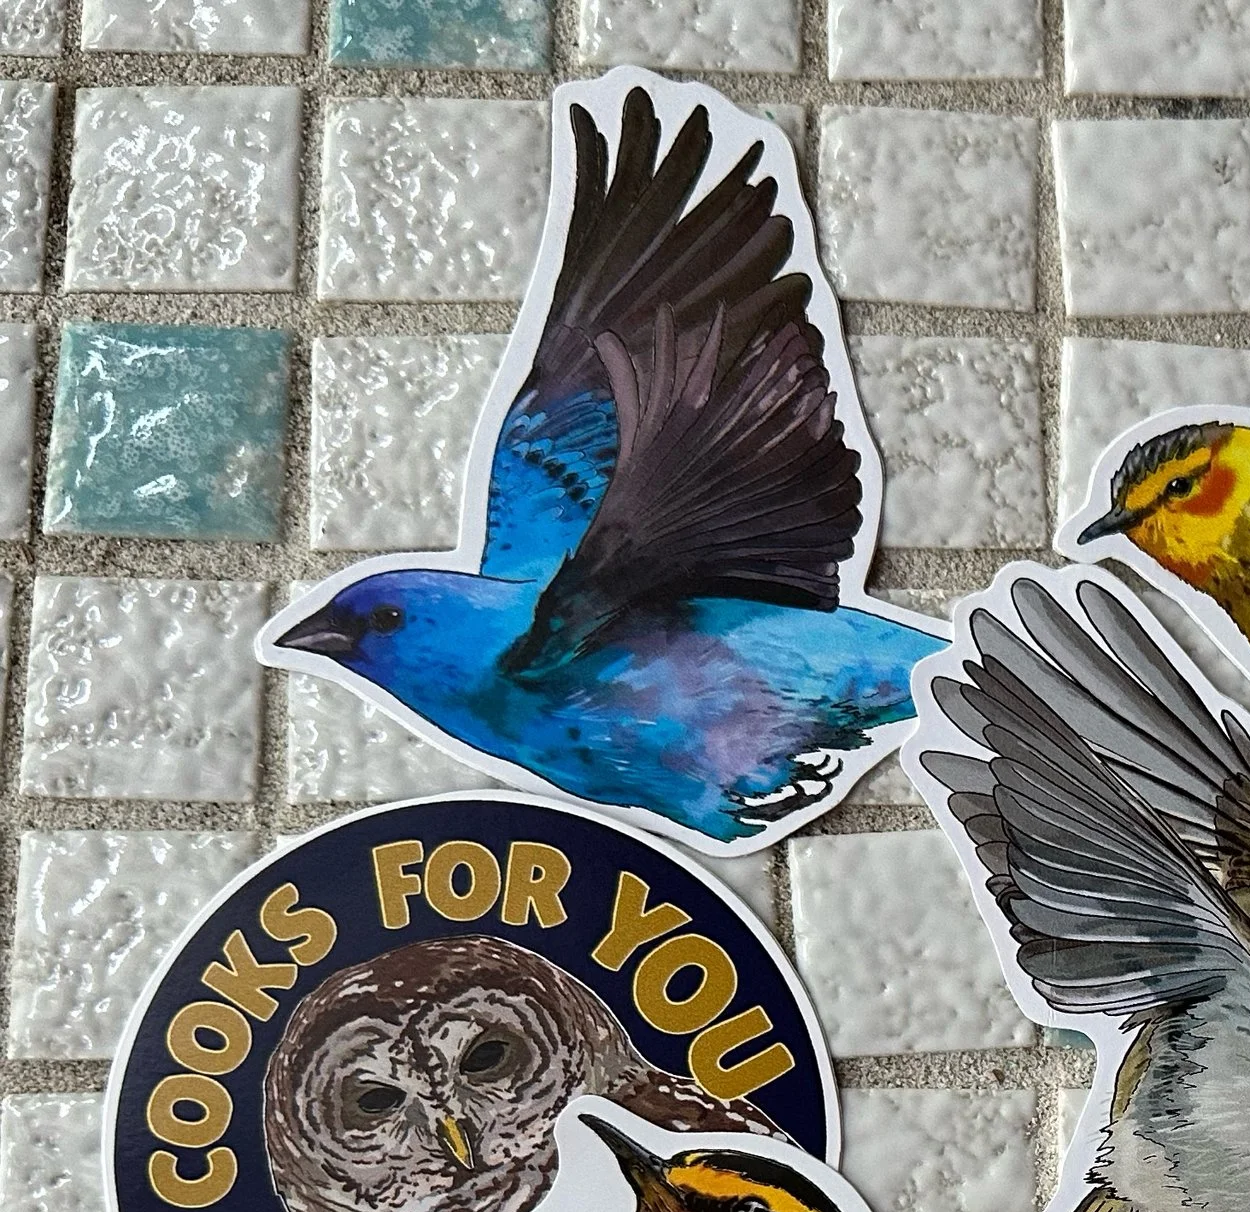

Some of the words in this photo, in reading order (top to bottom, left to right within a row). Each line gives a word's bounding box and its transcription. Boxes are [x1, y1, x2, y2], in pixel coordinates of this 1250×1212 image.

[147, 882, 338, 1208] COOKS
[372, 840, 571, 929] FOR
[591, 871, 794, 1099] YOU
